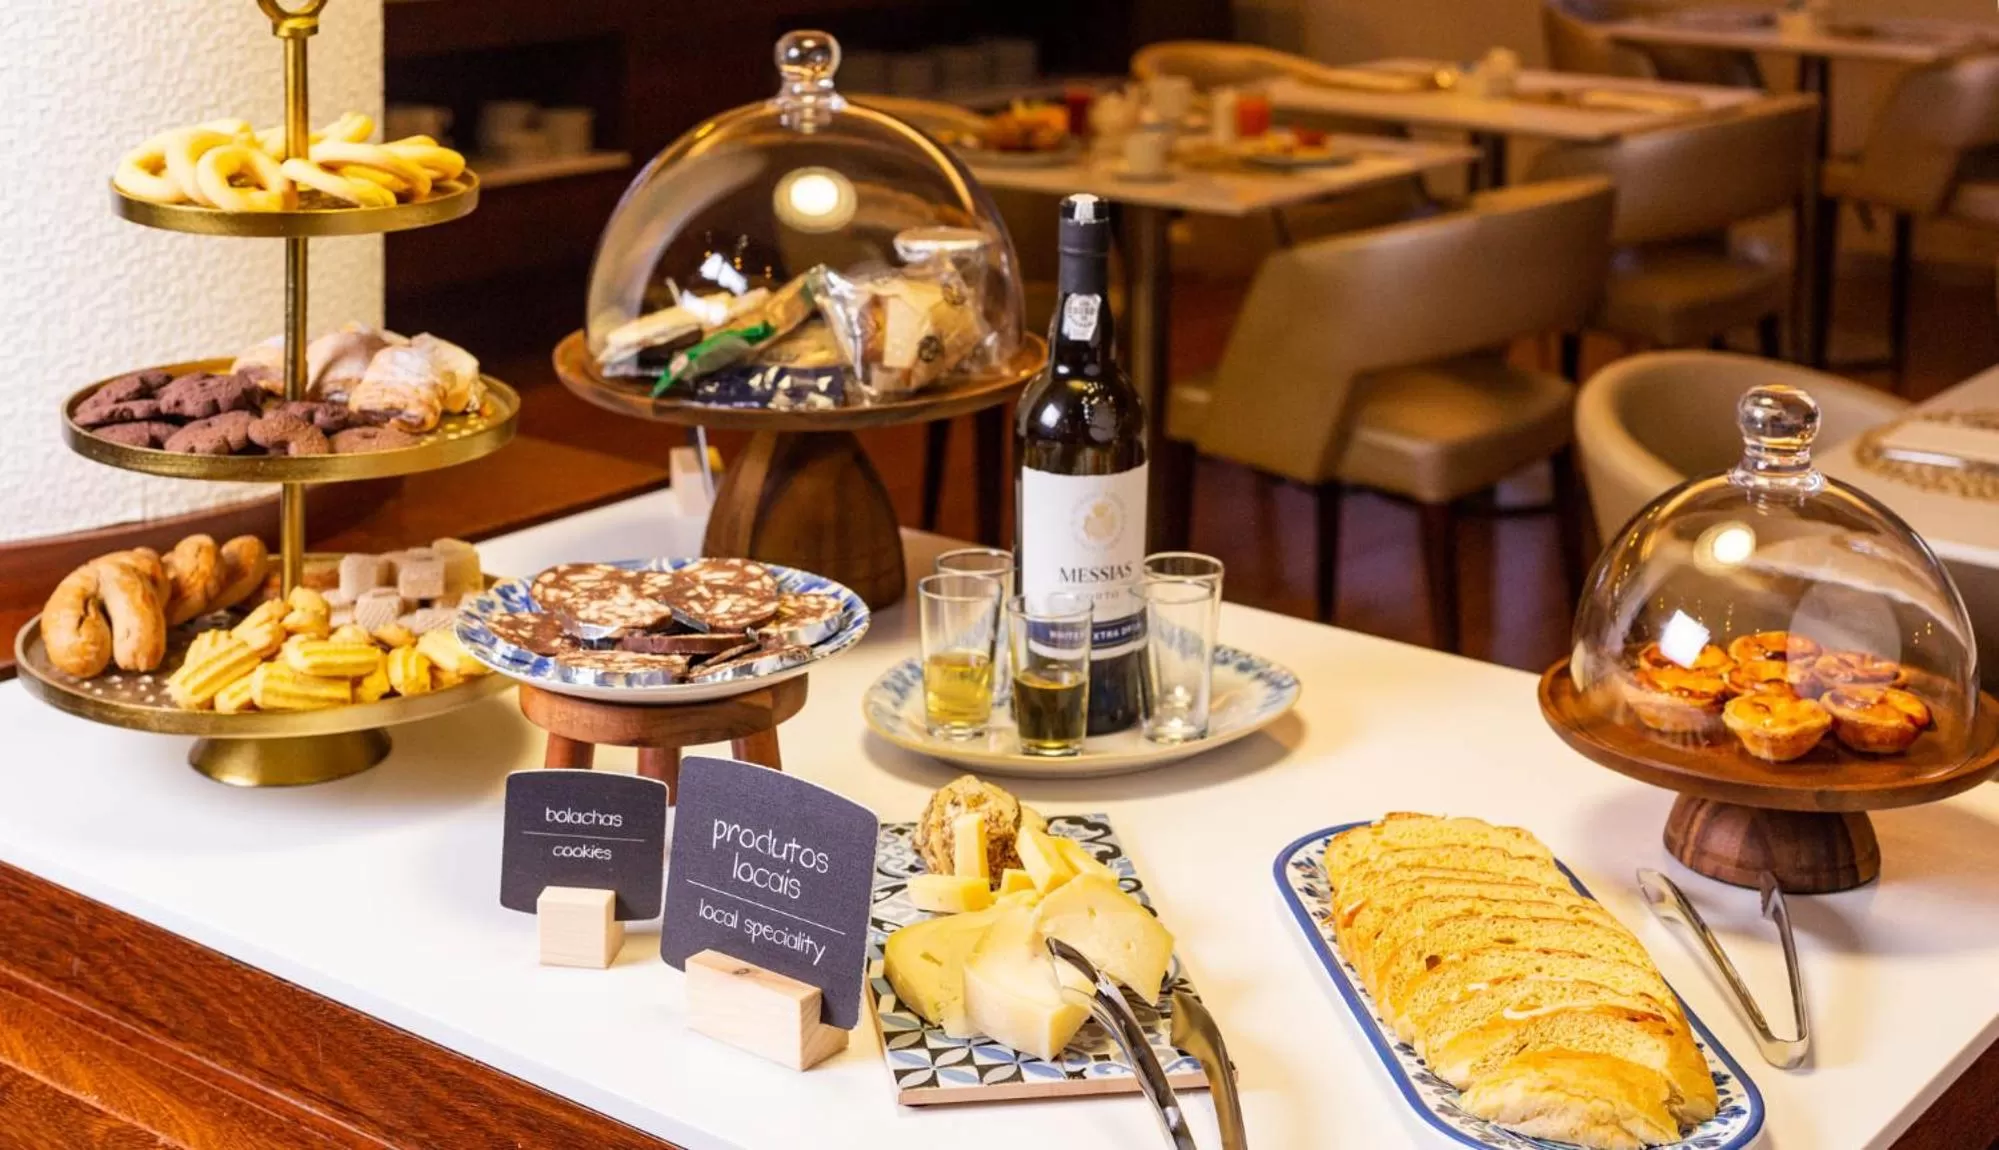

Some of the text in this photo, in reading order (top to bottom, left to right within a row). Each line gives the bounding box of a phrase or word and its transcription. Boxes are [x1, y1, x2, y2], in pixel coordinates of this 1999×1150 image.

[1058, 564, 1132, 583] MESSIAS
[1087, 629, 1119, 642] XTRA
[545, 806, 623, 827] bolachas
[552, 843, 612, 860] cookies
[712, 818, 829, 874] produtos
[732, 851, 801, 899] locais
[699, 898, 826, 966] local speciality
